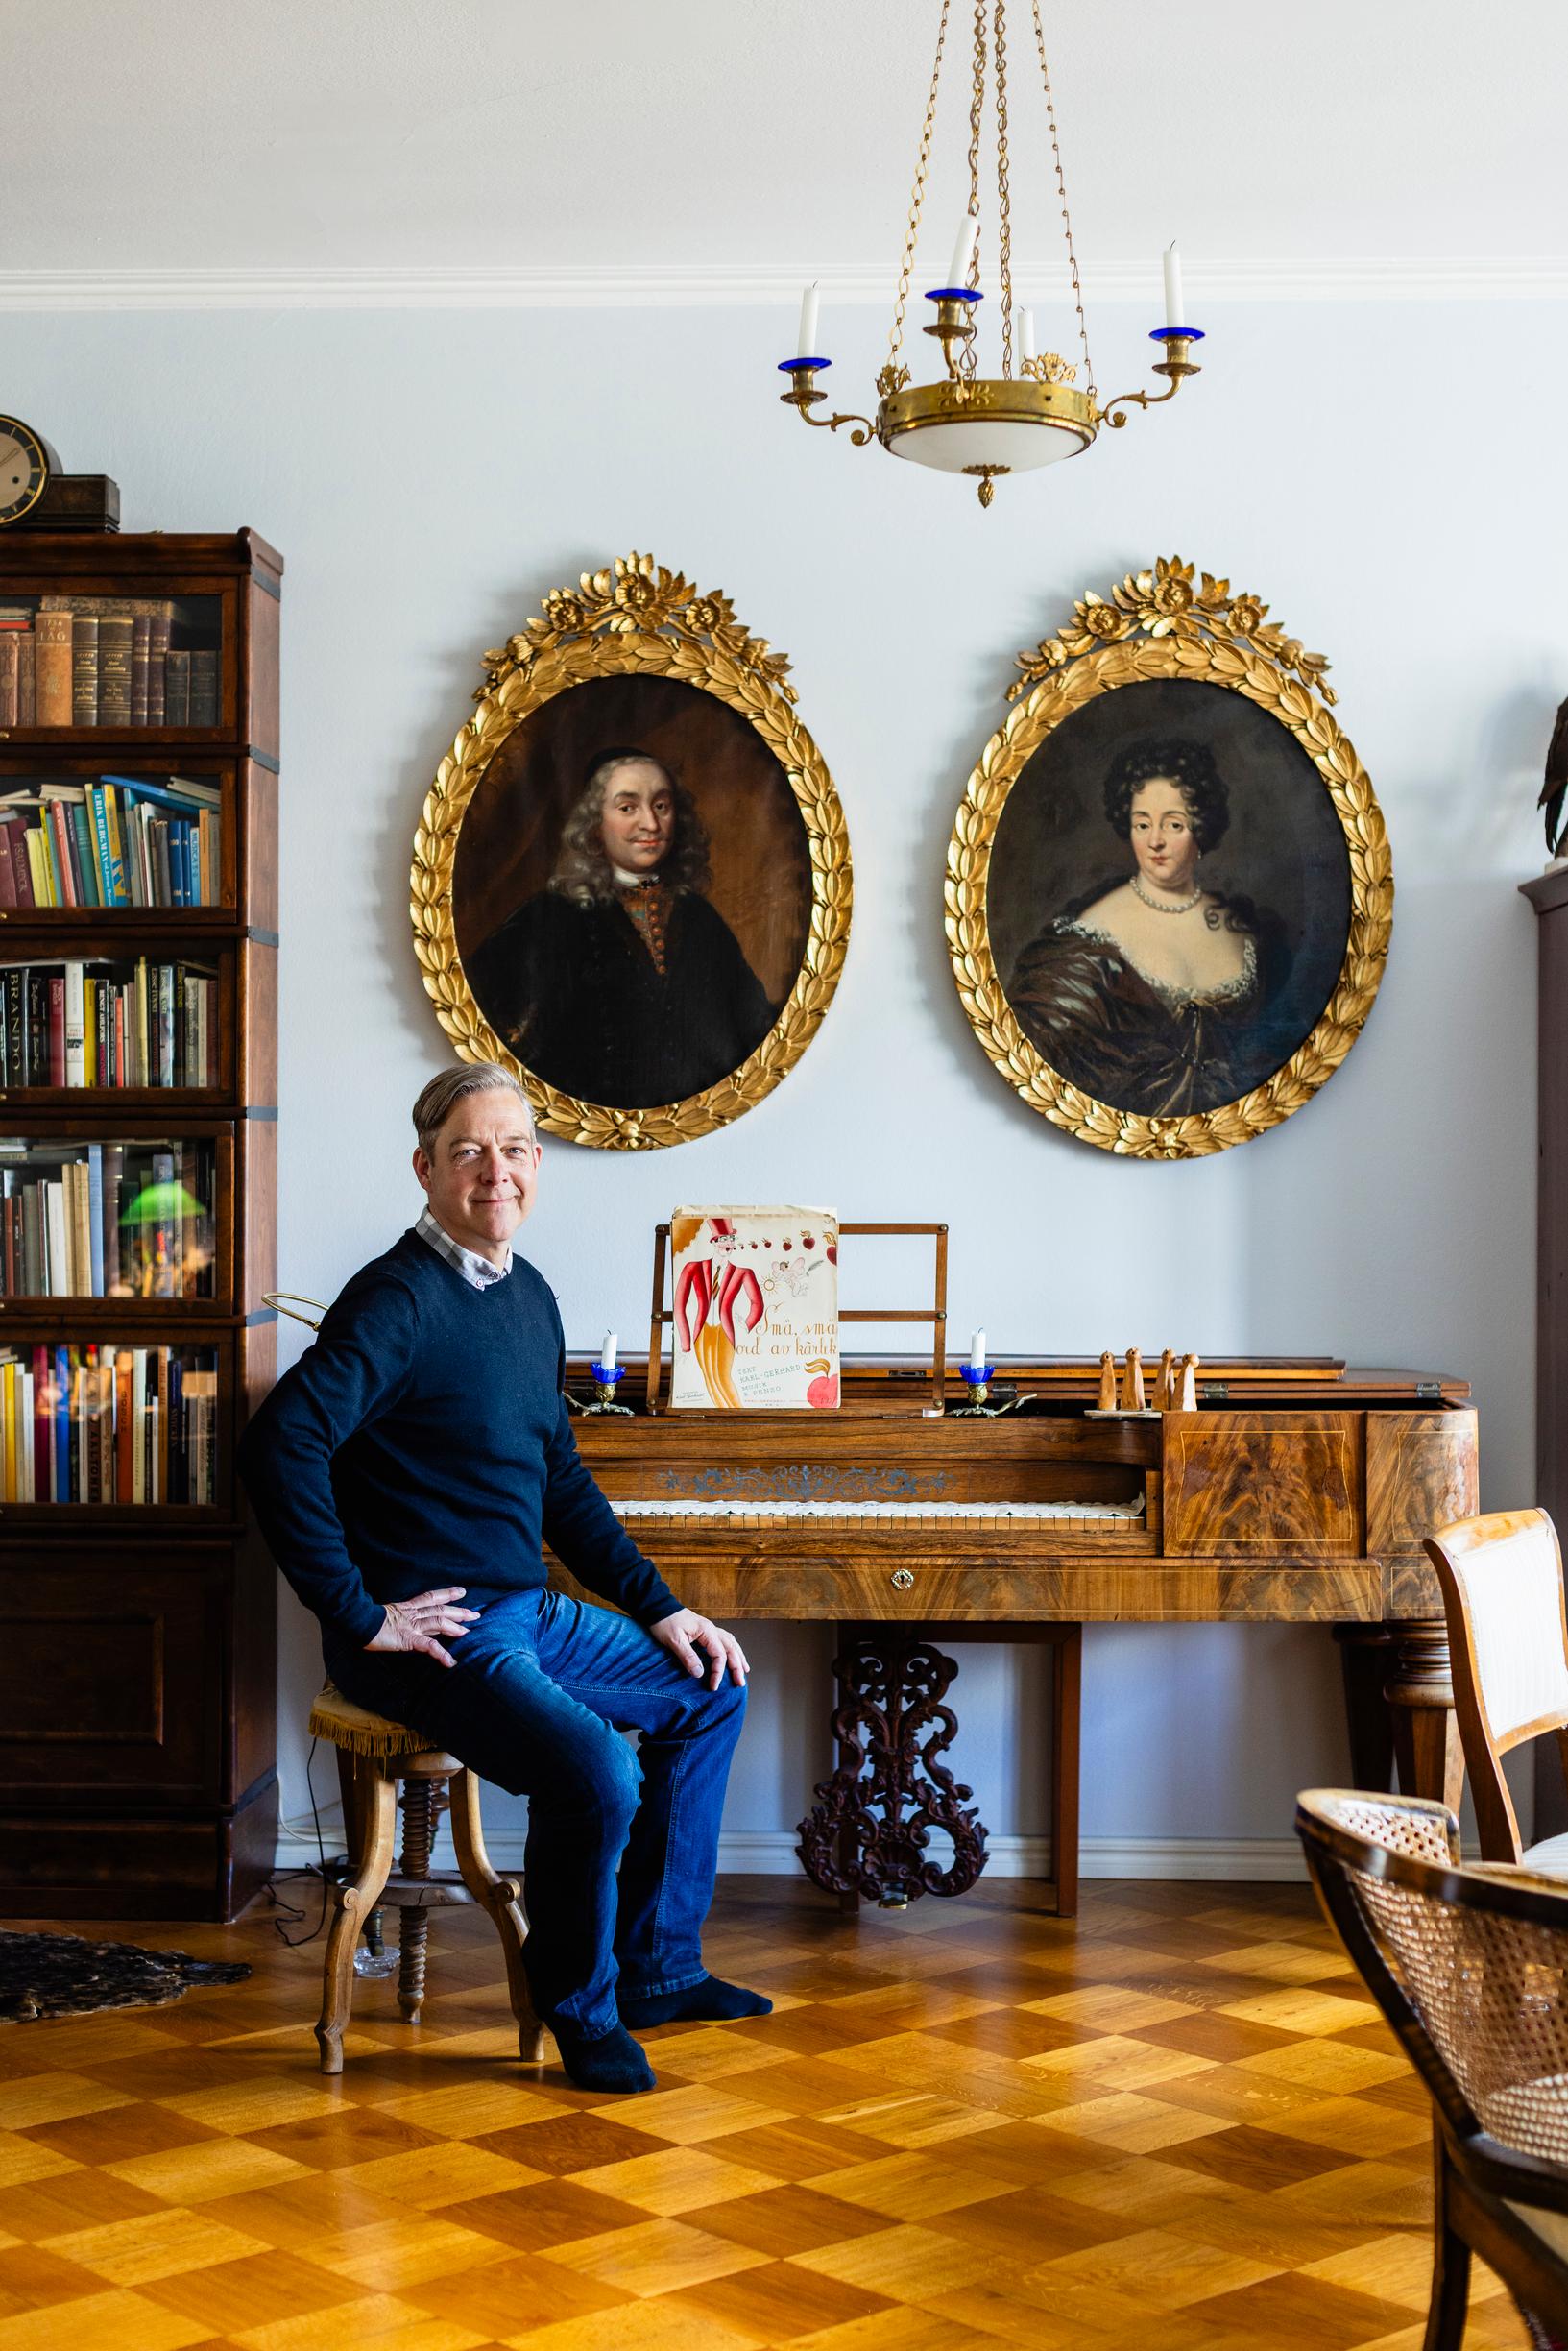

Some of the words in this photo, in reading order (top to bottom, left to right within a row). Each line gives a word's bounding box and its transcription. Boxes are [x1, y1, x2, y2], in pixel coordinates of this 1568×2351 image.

[94, 794, 105, 816] ERIK
[97, 818, 109, 862] BERGMAN
[10, 973, 21, 1070] BRANDO
[736, 1337, 760, 1355] ord
[771, 1344, 790, 1355] av
[736, 1366, 757, 1375] TEXT
